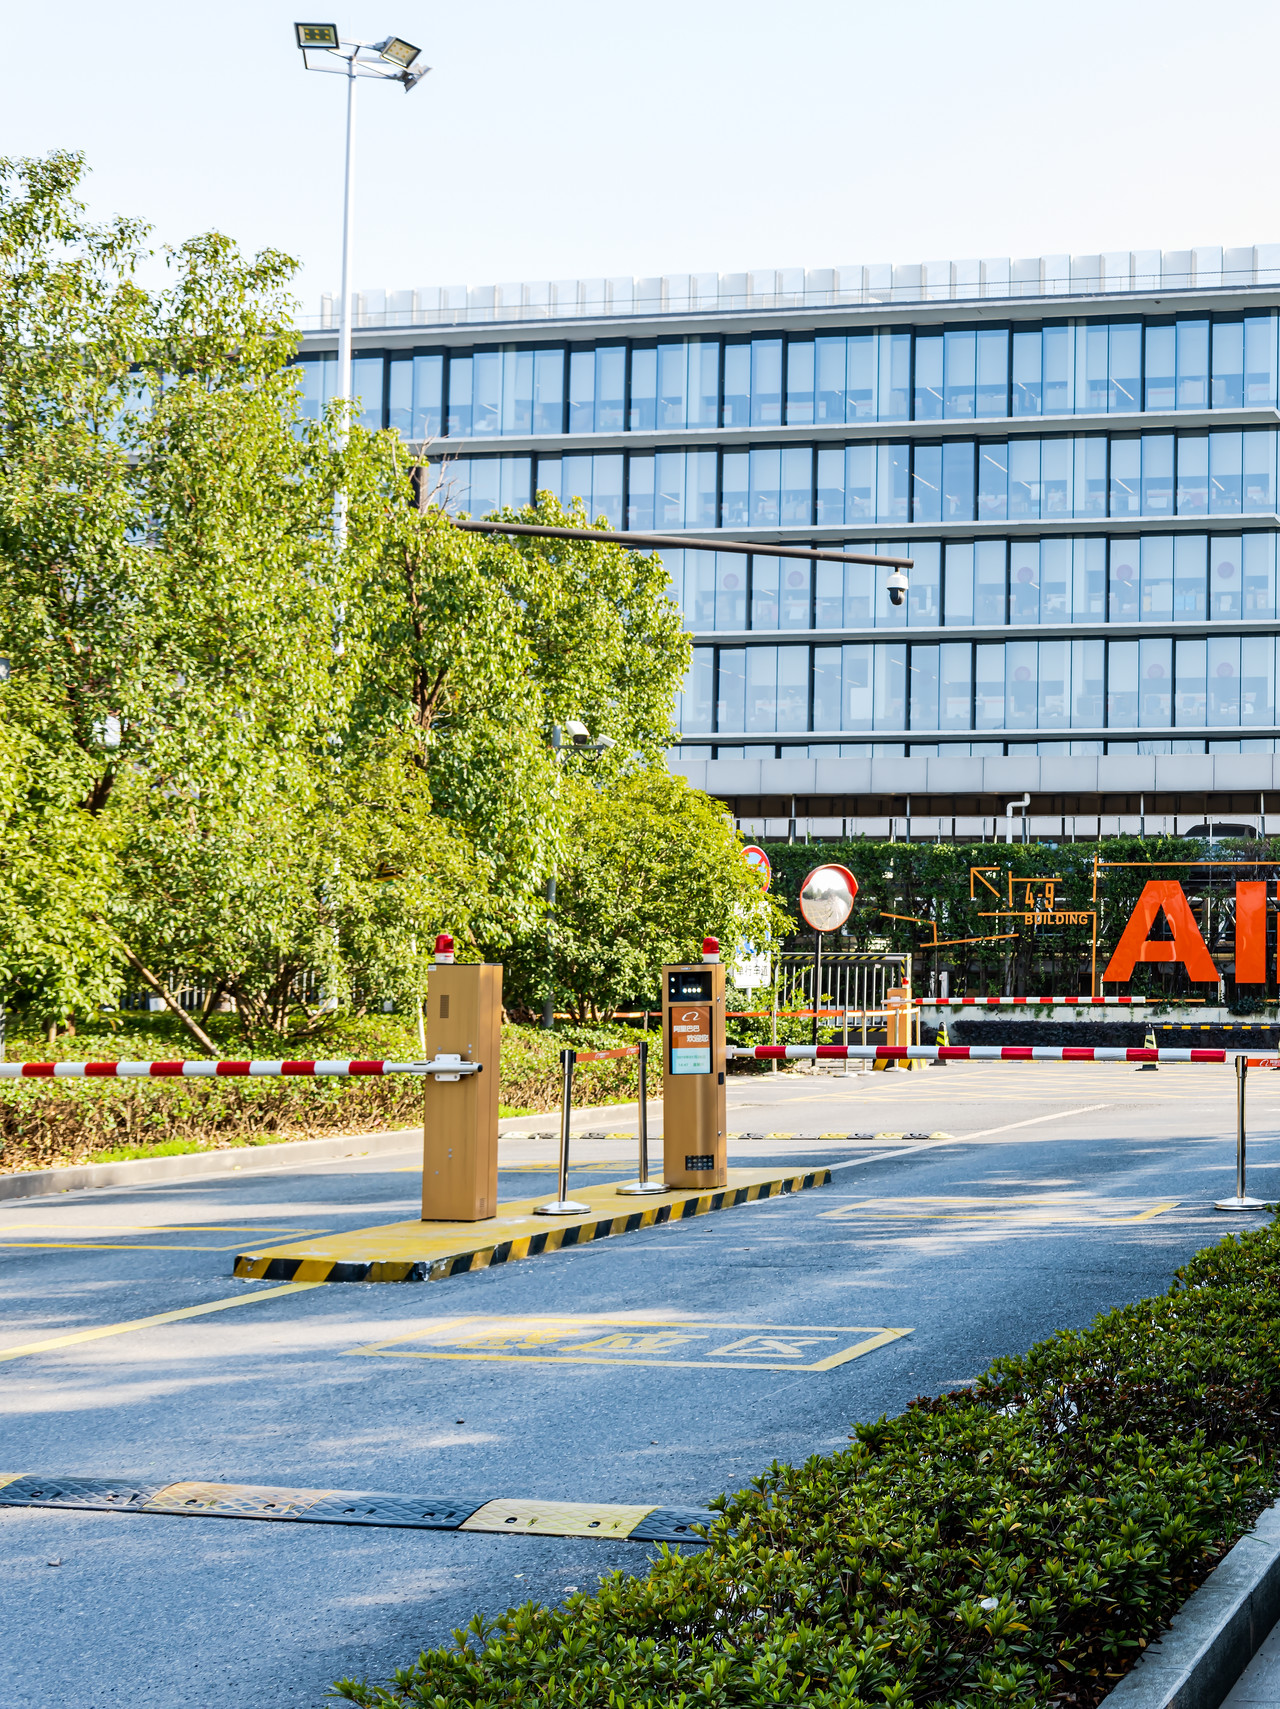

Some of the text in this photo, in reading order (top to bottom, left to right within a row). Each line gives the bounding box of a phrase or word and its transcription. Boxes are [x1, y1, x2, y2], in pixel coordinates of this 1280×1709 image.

[1025, 883, 1054, 908] 4-9
[1024, 914, 1088, 925] BUILDING
[431, 1328, 839, 1358] 感应区
